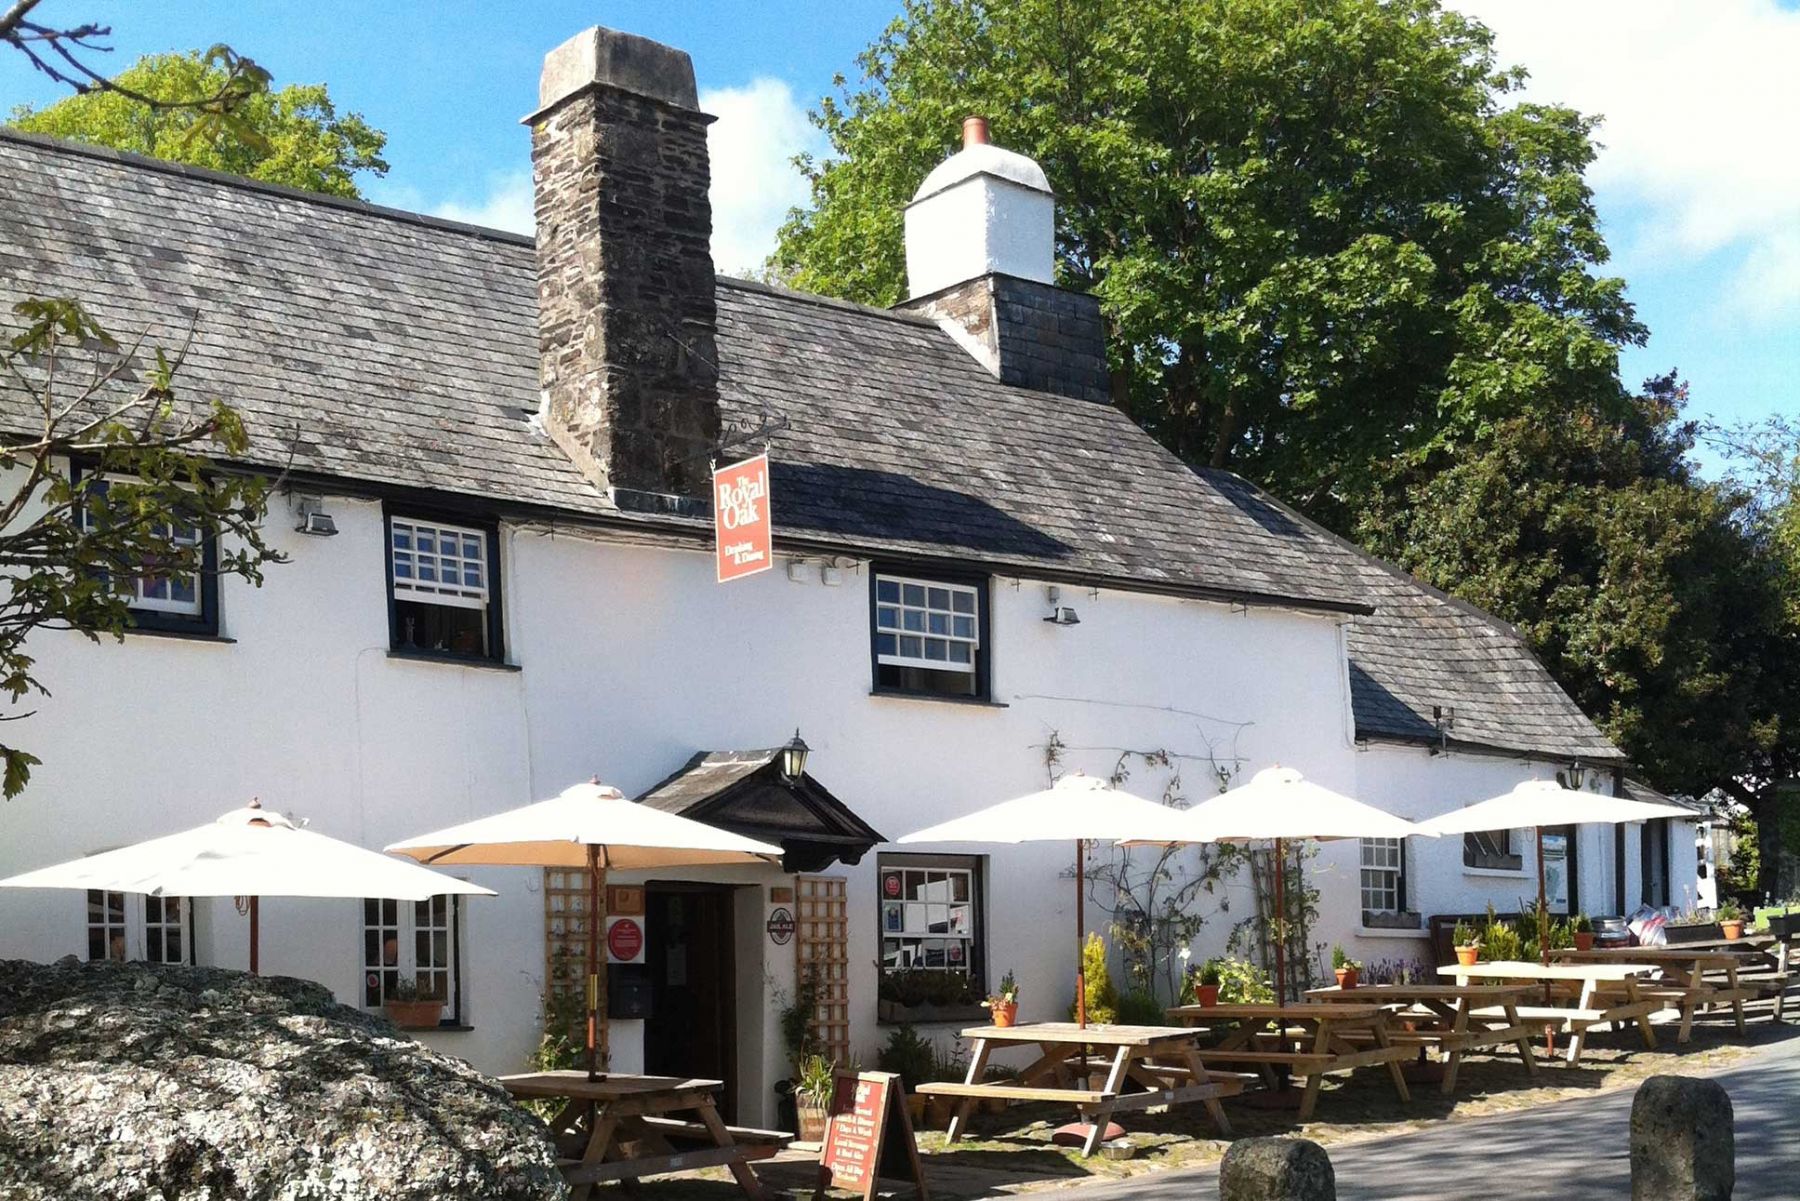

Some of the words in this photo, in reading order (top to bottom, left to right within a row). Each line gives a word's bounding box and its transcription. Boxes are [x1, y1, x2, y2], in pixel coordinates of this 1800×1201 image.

[719, 470, 765, 510] Royal
[723, 498, 760, 529] Oak
[725, 542, 753, 556] Drinking
[734, 552, 741, 565] &
[742, 550, 765, 563] Dining
